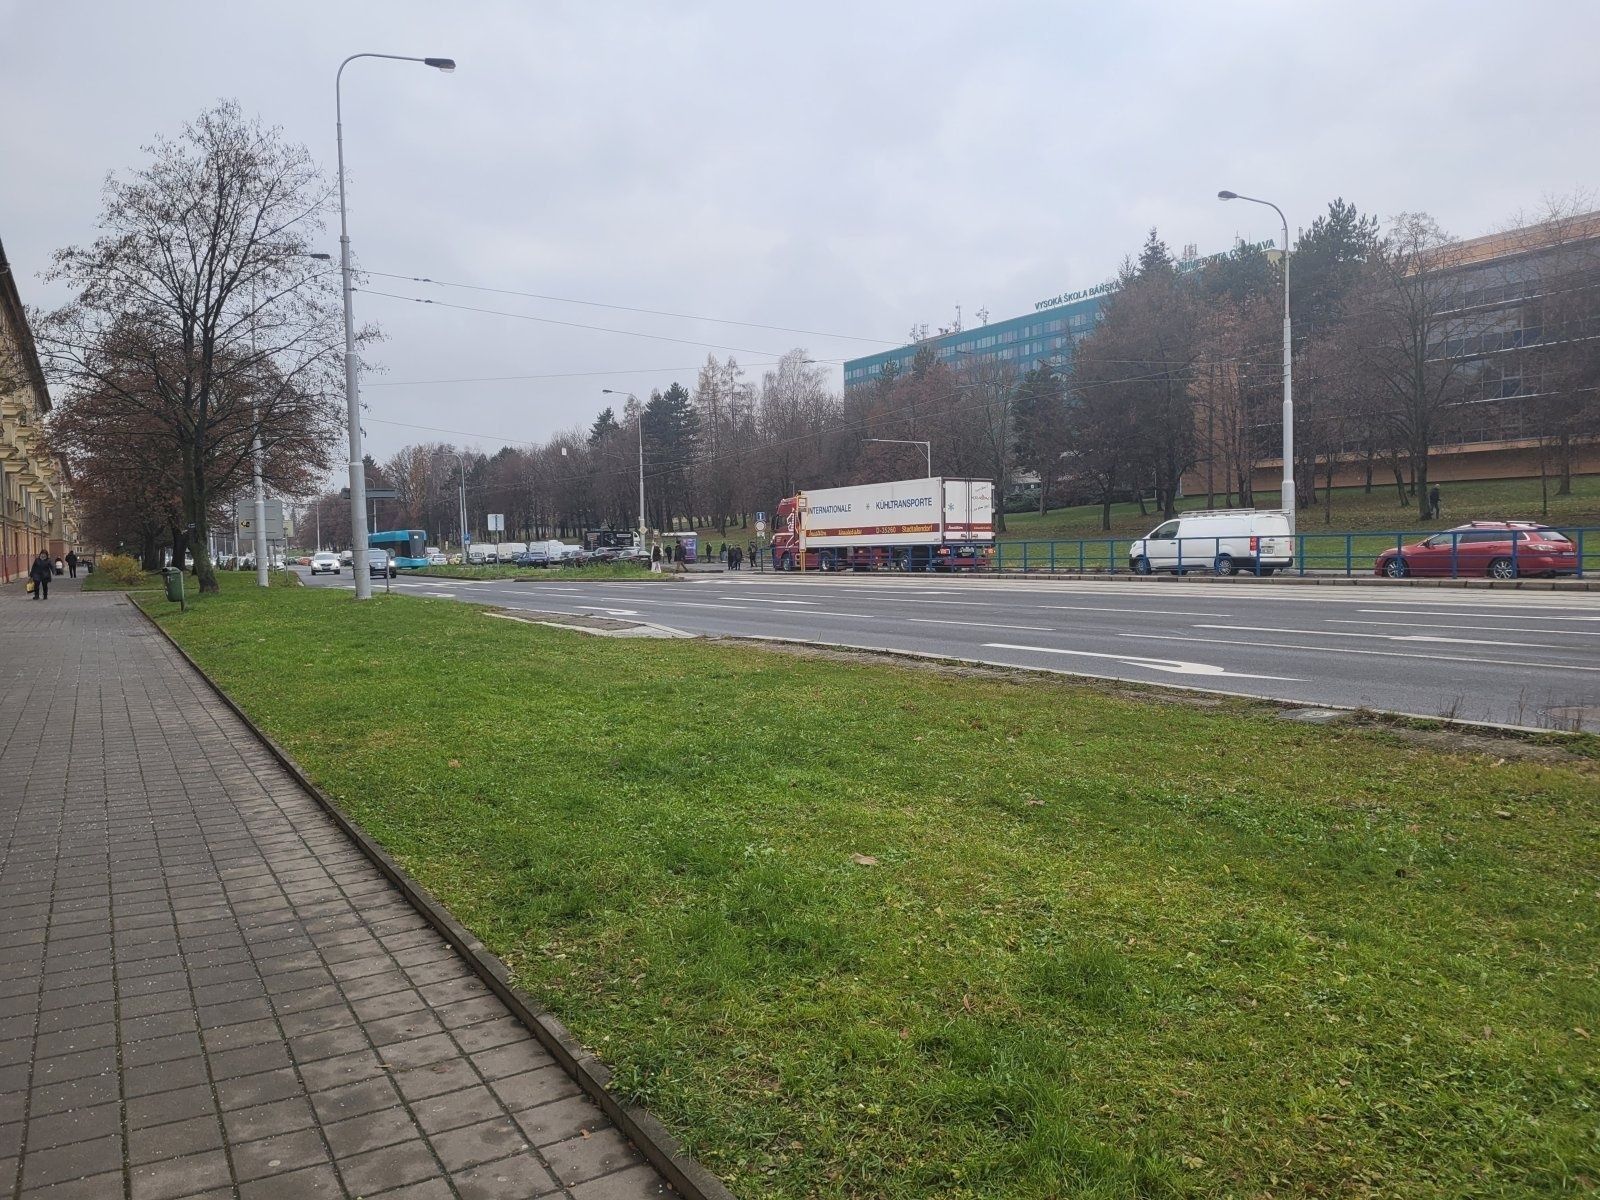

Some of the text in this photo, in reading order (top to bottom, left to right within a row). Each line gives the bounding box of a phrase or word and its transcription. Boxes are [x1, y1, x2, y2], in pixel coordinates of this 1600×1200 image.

[1034, 294, 1063, 310] VYSOKÁ
[1063, 289, 1088, 303] ŠKOLA
[808, 497, 933, 515] INTERNATIONALE KÜHLTRANSPORTE
